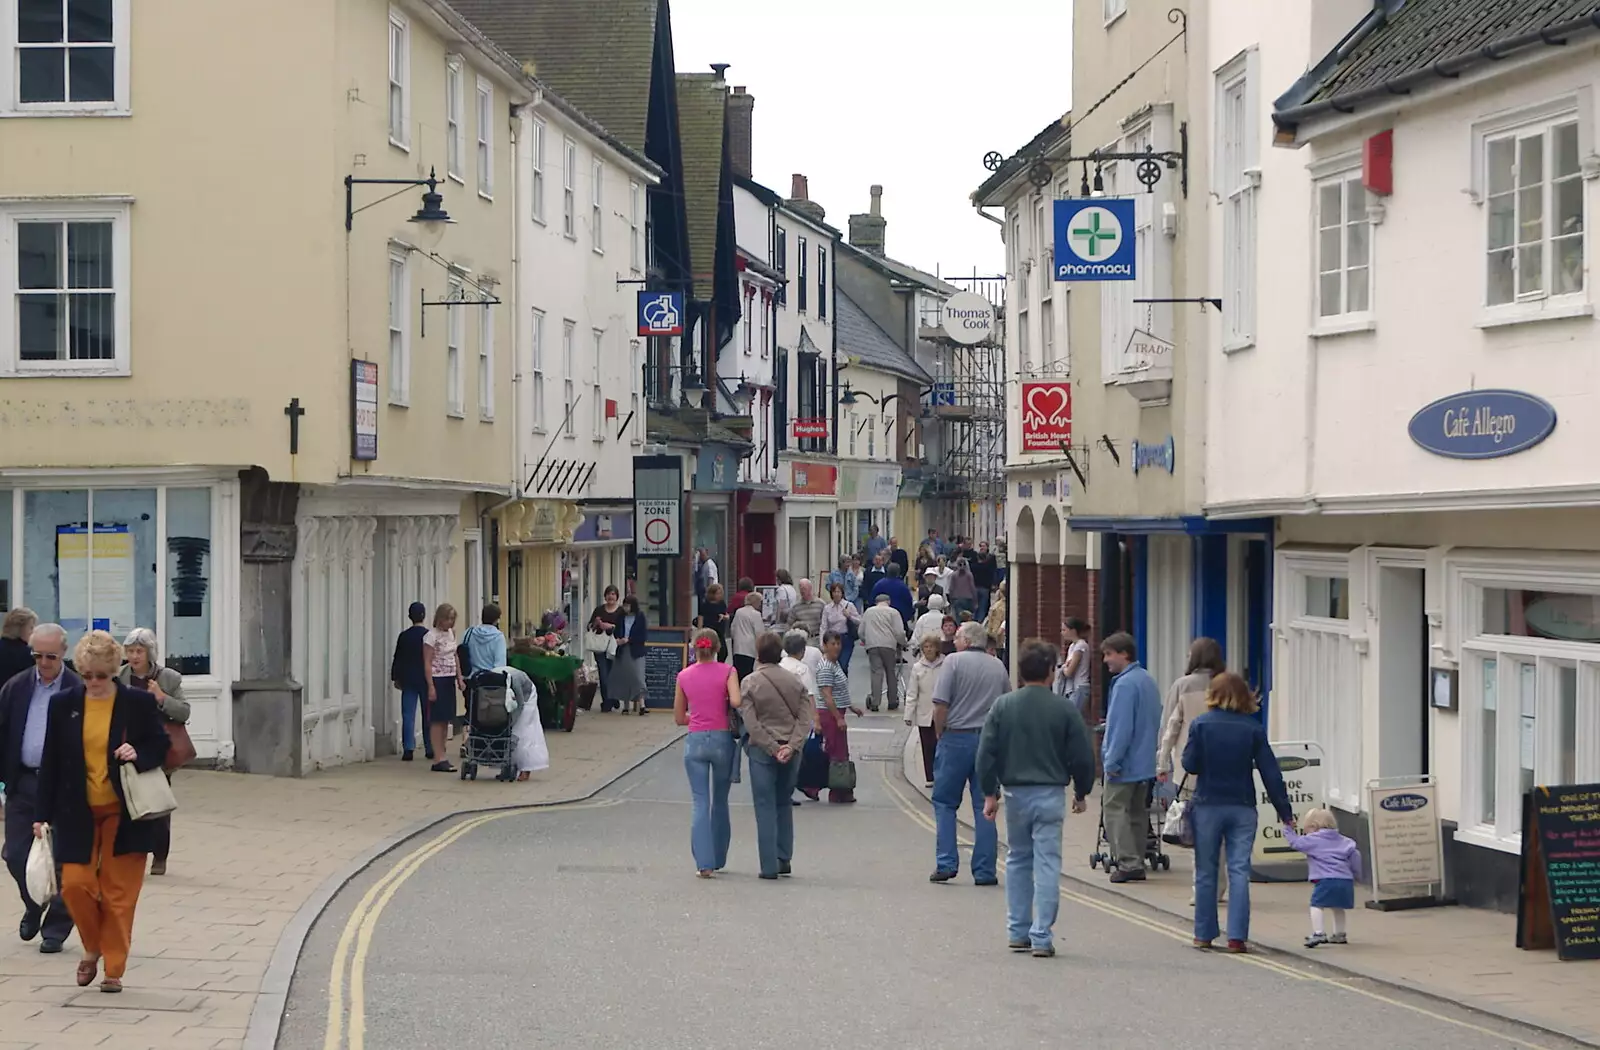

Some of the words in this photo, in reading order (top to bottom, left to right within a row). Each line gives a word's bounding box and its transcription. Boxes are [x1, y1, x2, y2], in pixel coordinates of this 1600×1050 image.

[1059, 264, 1131, 276] pharmacy
[946, 307, 991, 319] Thomas
[962, 319, 990, 329] Cook
[1443, 407, 1470, 438] Café
[1472, 406, 1516, 443] Allegro
[644, 507, 671, 515] ZONE
